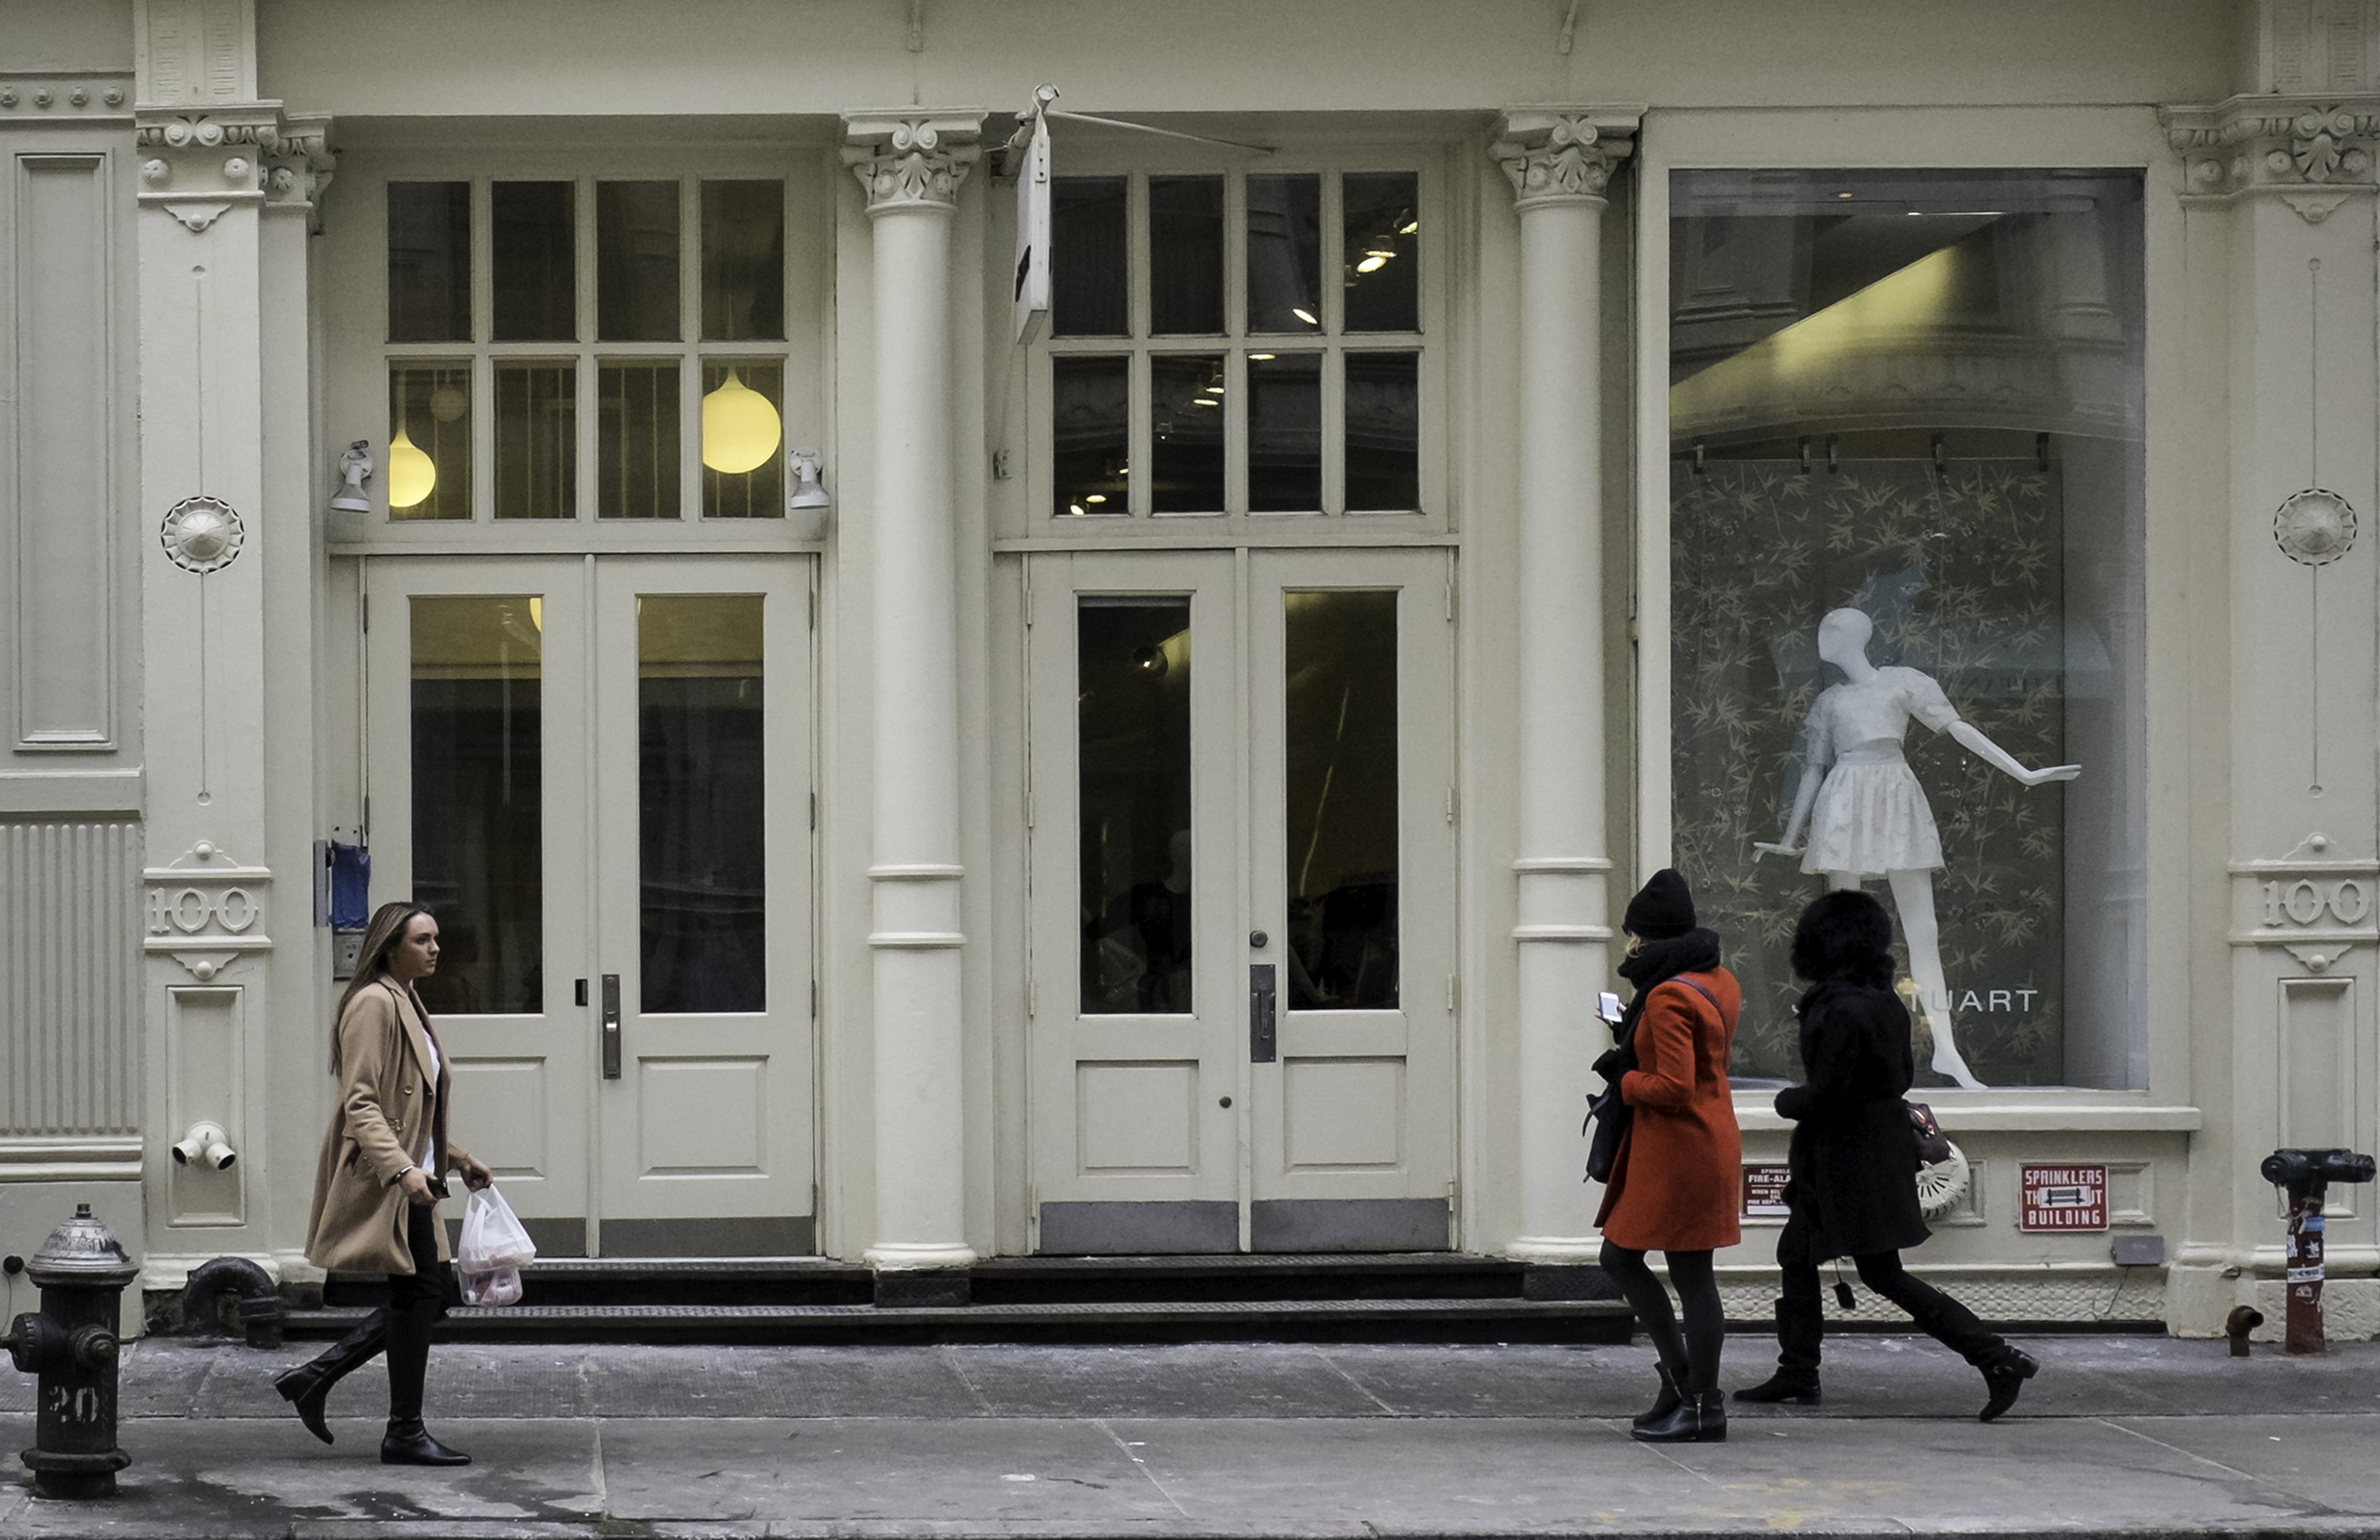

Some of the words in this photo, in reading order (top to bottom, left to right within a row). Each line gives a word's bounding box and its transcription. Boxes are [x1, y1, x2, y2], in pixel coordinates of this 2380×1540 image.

[150, 886, 259, 934] 100
[2264, 879, 2370, 927] 100
[2025, 1170, 2102, 1185] SPRINKLERS
[2028, 1210, 2100, 1225] BUILDING
